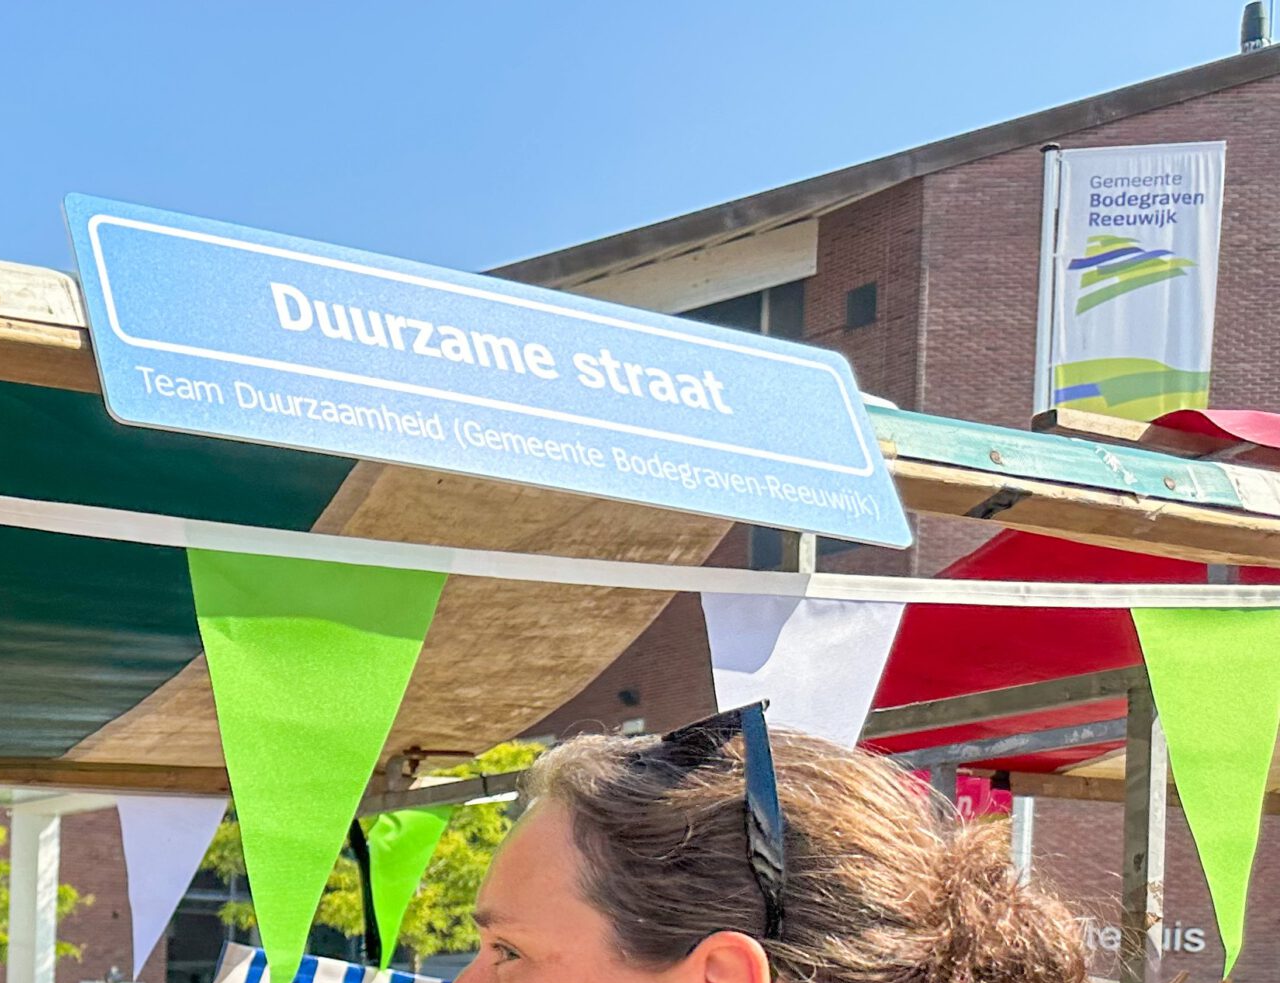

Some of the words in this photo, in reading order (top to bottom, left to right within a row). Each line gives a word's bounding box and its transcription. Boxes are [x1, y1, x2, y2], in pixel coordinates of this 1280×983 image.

[1089, 173, 1183, 189] Gemeente
[1090, 192, 1204, 209] Bodegraven
[1088, 209, 1178, 228] Reeuwijk
[270, 281, 559, 379] Duurzame
[573, 348, 734, 415] straat
[135, 365, 225, 404] Team
[234, 380, 444, 442] Duurzaamheid
[454, 417, 606, 470] (Gemeente
[612, 446, 881, 520] Bodegraven-Reeuwijk)
